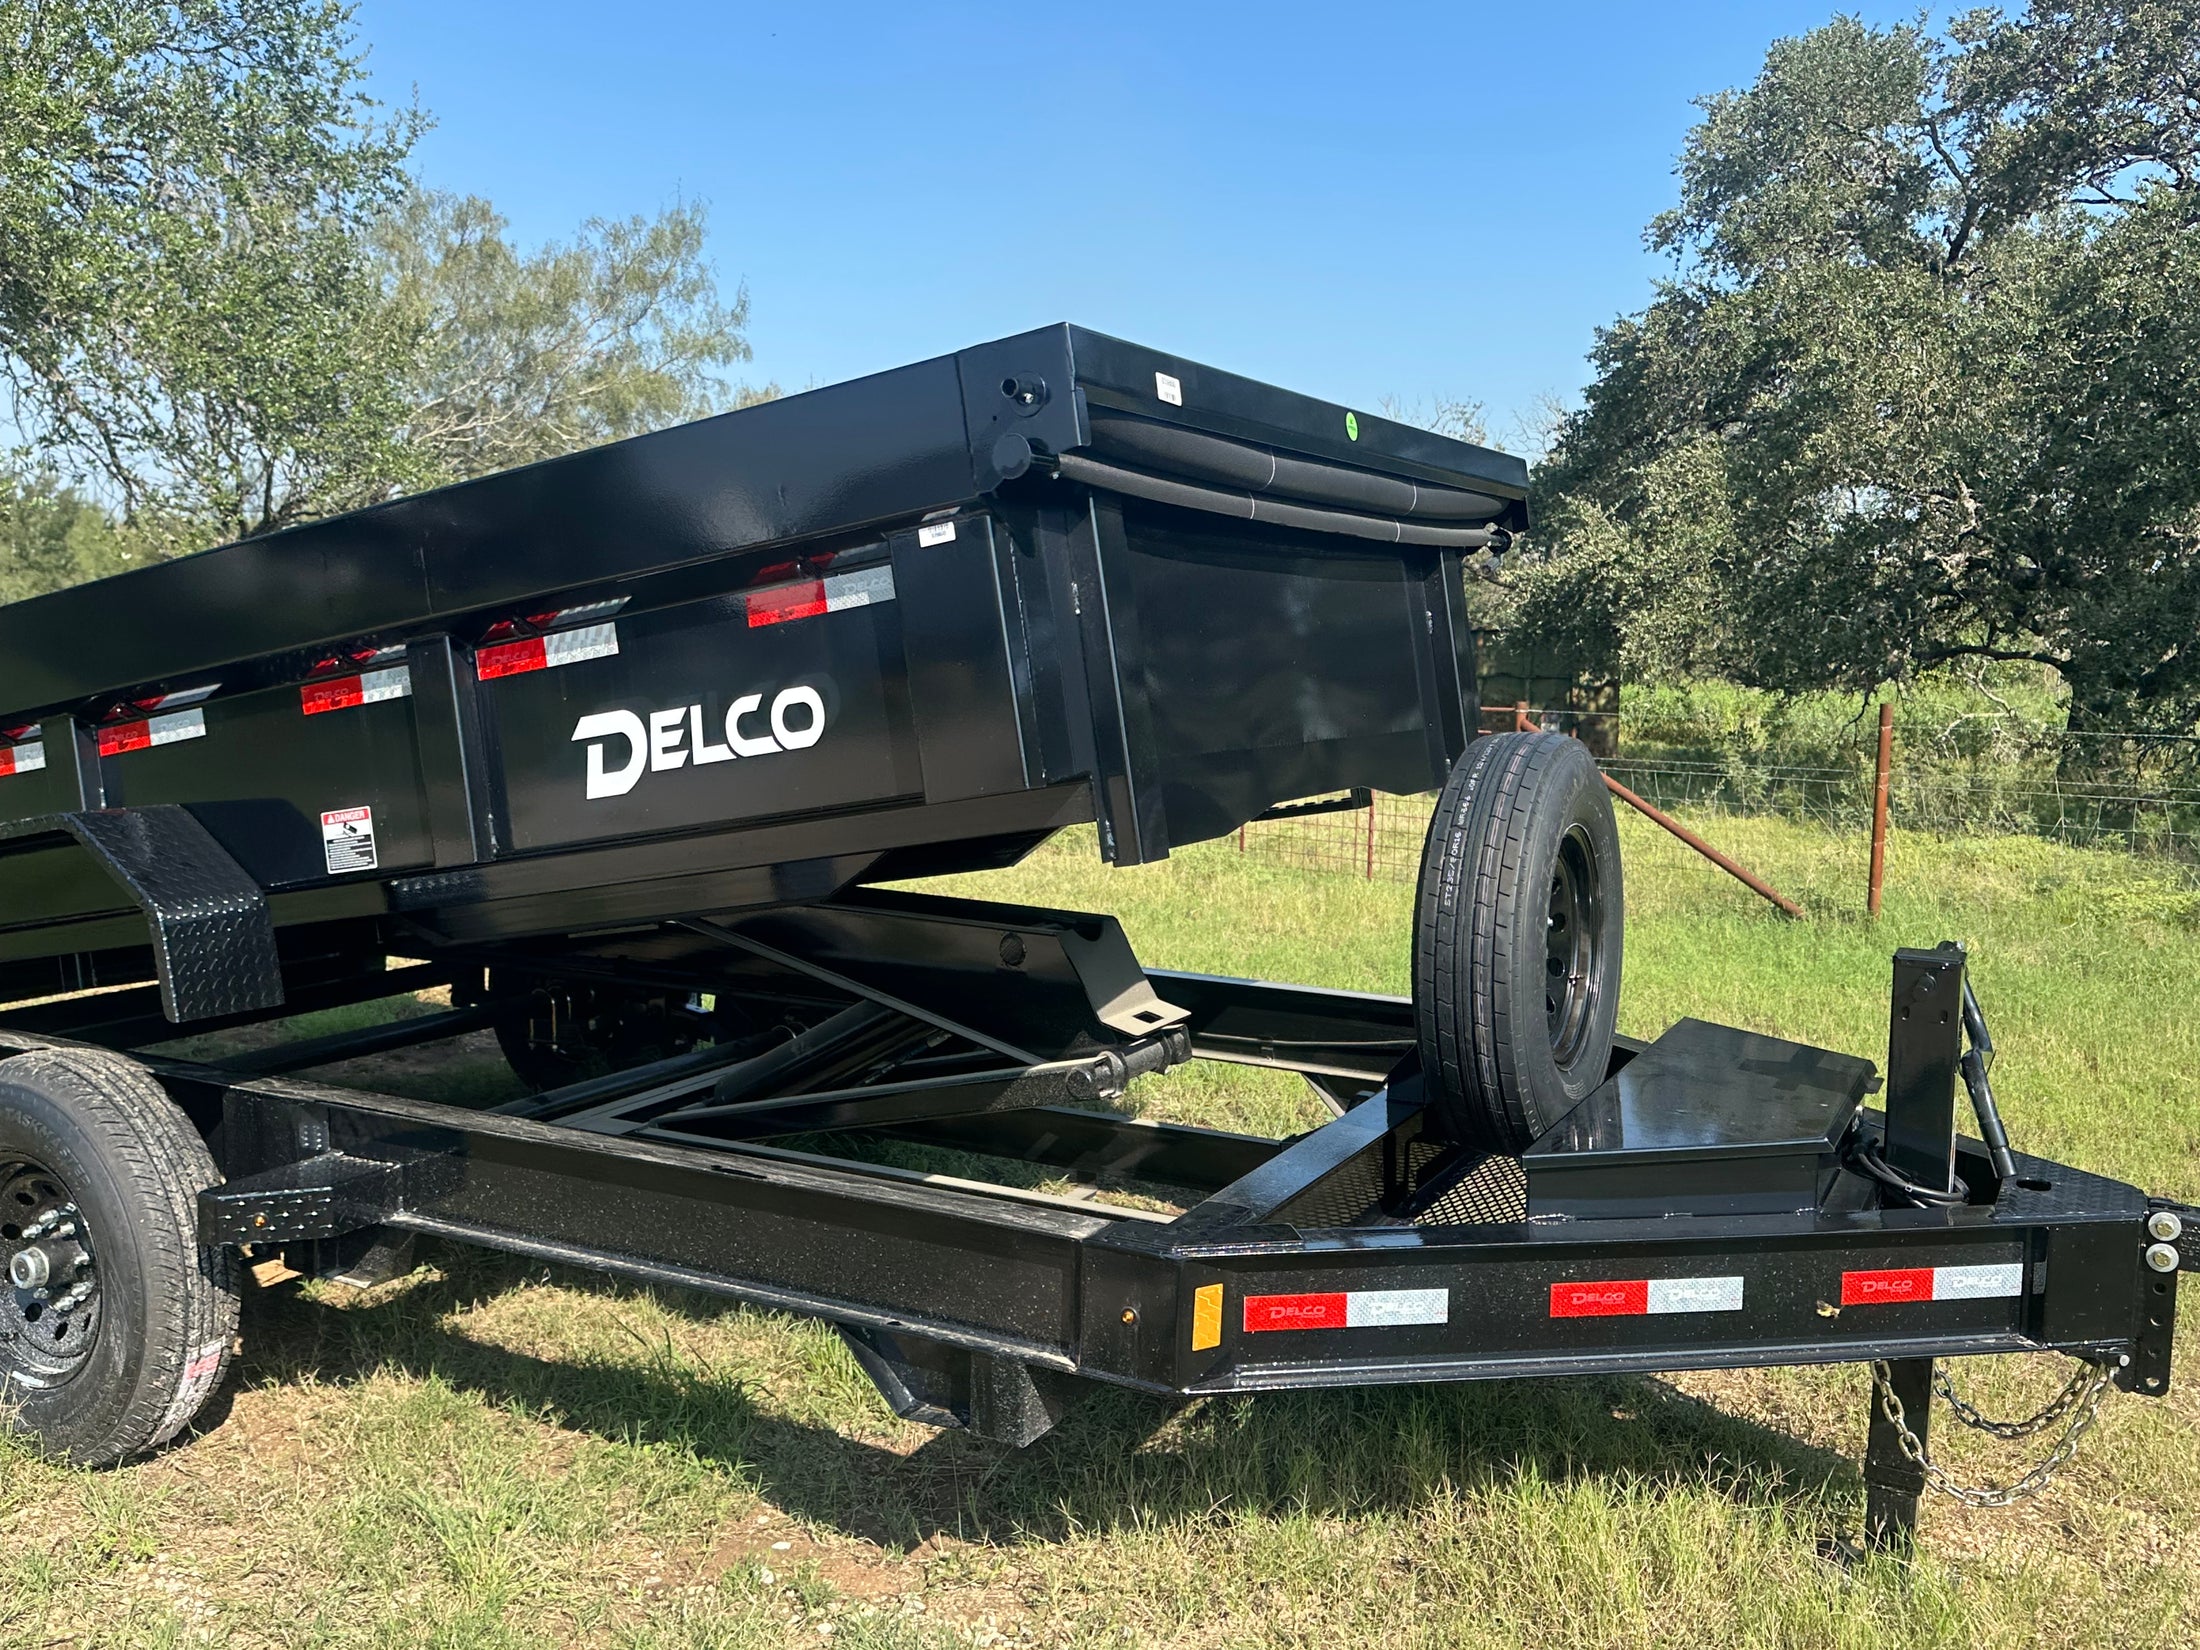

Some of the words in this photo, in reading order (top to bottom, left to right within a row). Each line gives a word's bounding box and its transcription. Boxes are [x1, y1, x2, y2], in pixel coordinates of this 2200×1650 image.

[843, 577, 889, 594] DELCO
[314, 687, 350, 701] DELCO
[571, 685, 826, 800] DELCO
[334, 810, 366, 823] DANGER
[1861, 1280, 1913, 1294] DELCO
[1952, 1274, 2003, 1288] DELCO
[1569, 1292, 1626, 1306] DELCO
[1269, 1305, 1327, 1320] DELCO
